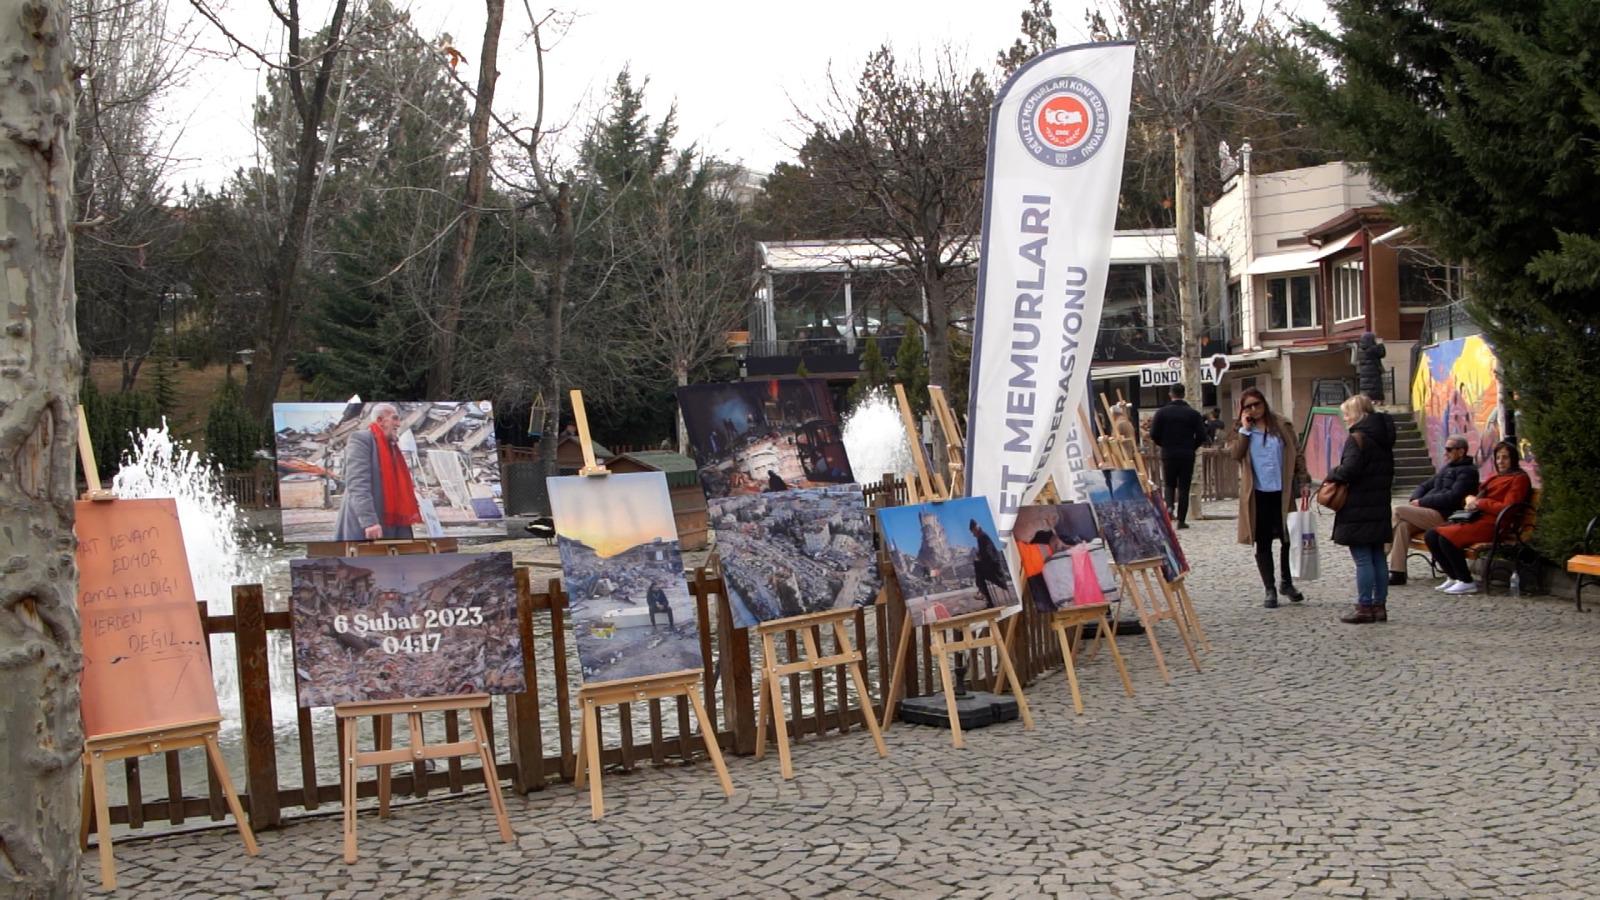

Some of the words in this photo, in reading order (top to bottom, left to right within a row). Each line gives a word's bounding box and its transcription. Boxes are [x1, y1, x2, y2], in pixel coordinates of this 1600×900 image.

[1023, 80, 1069, 117] MEMURLARI
[1069, 81, 1106, 158] KONFEDERASYONU
[1021, 119, 1043, 154] DEVLET
[1004, 194, 1051, 452] MEMURLARI
[110, 526, 160, 551] DEVAM
[82, 587, 117, 608] AMA
[88, 611, 142, 639] YERDEN
[334, 614, 349, 634] 6
[353, 611, 421, 638] Şubat
[424, 606, 484, 628] 2023
[382, 633, 442, 655] 04:17
